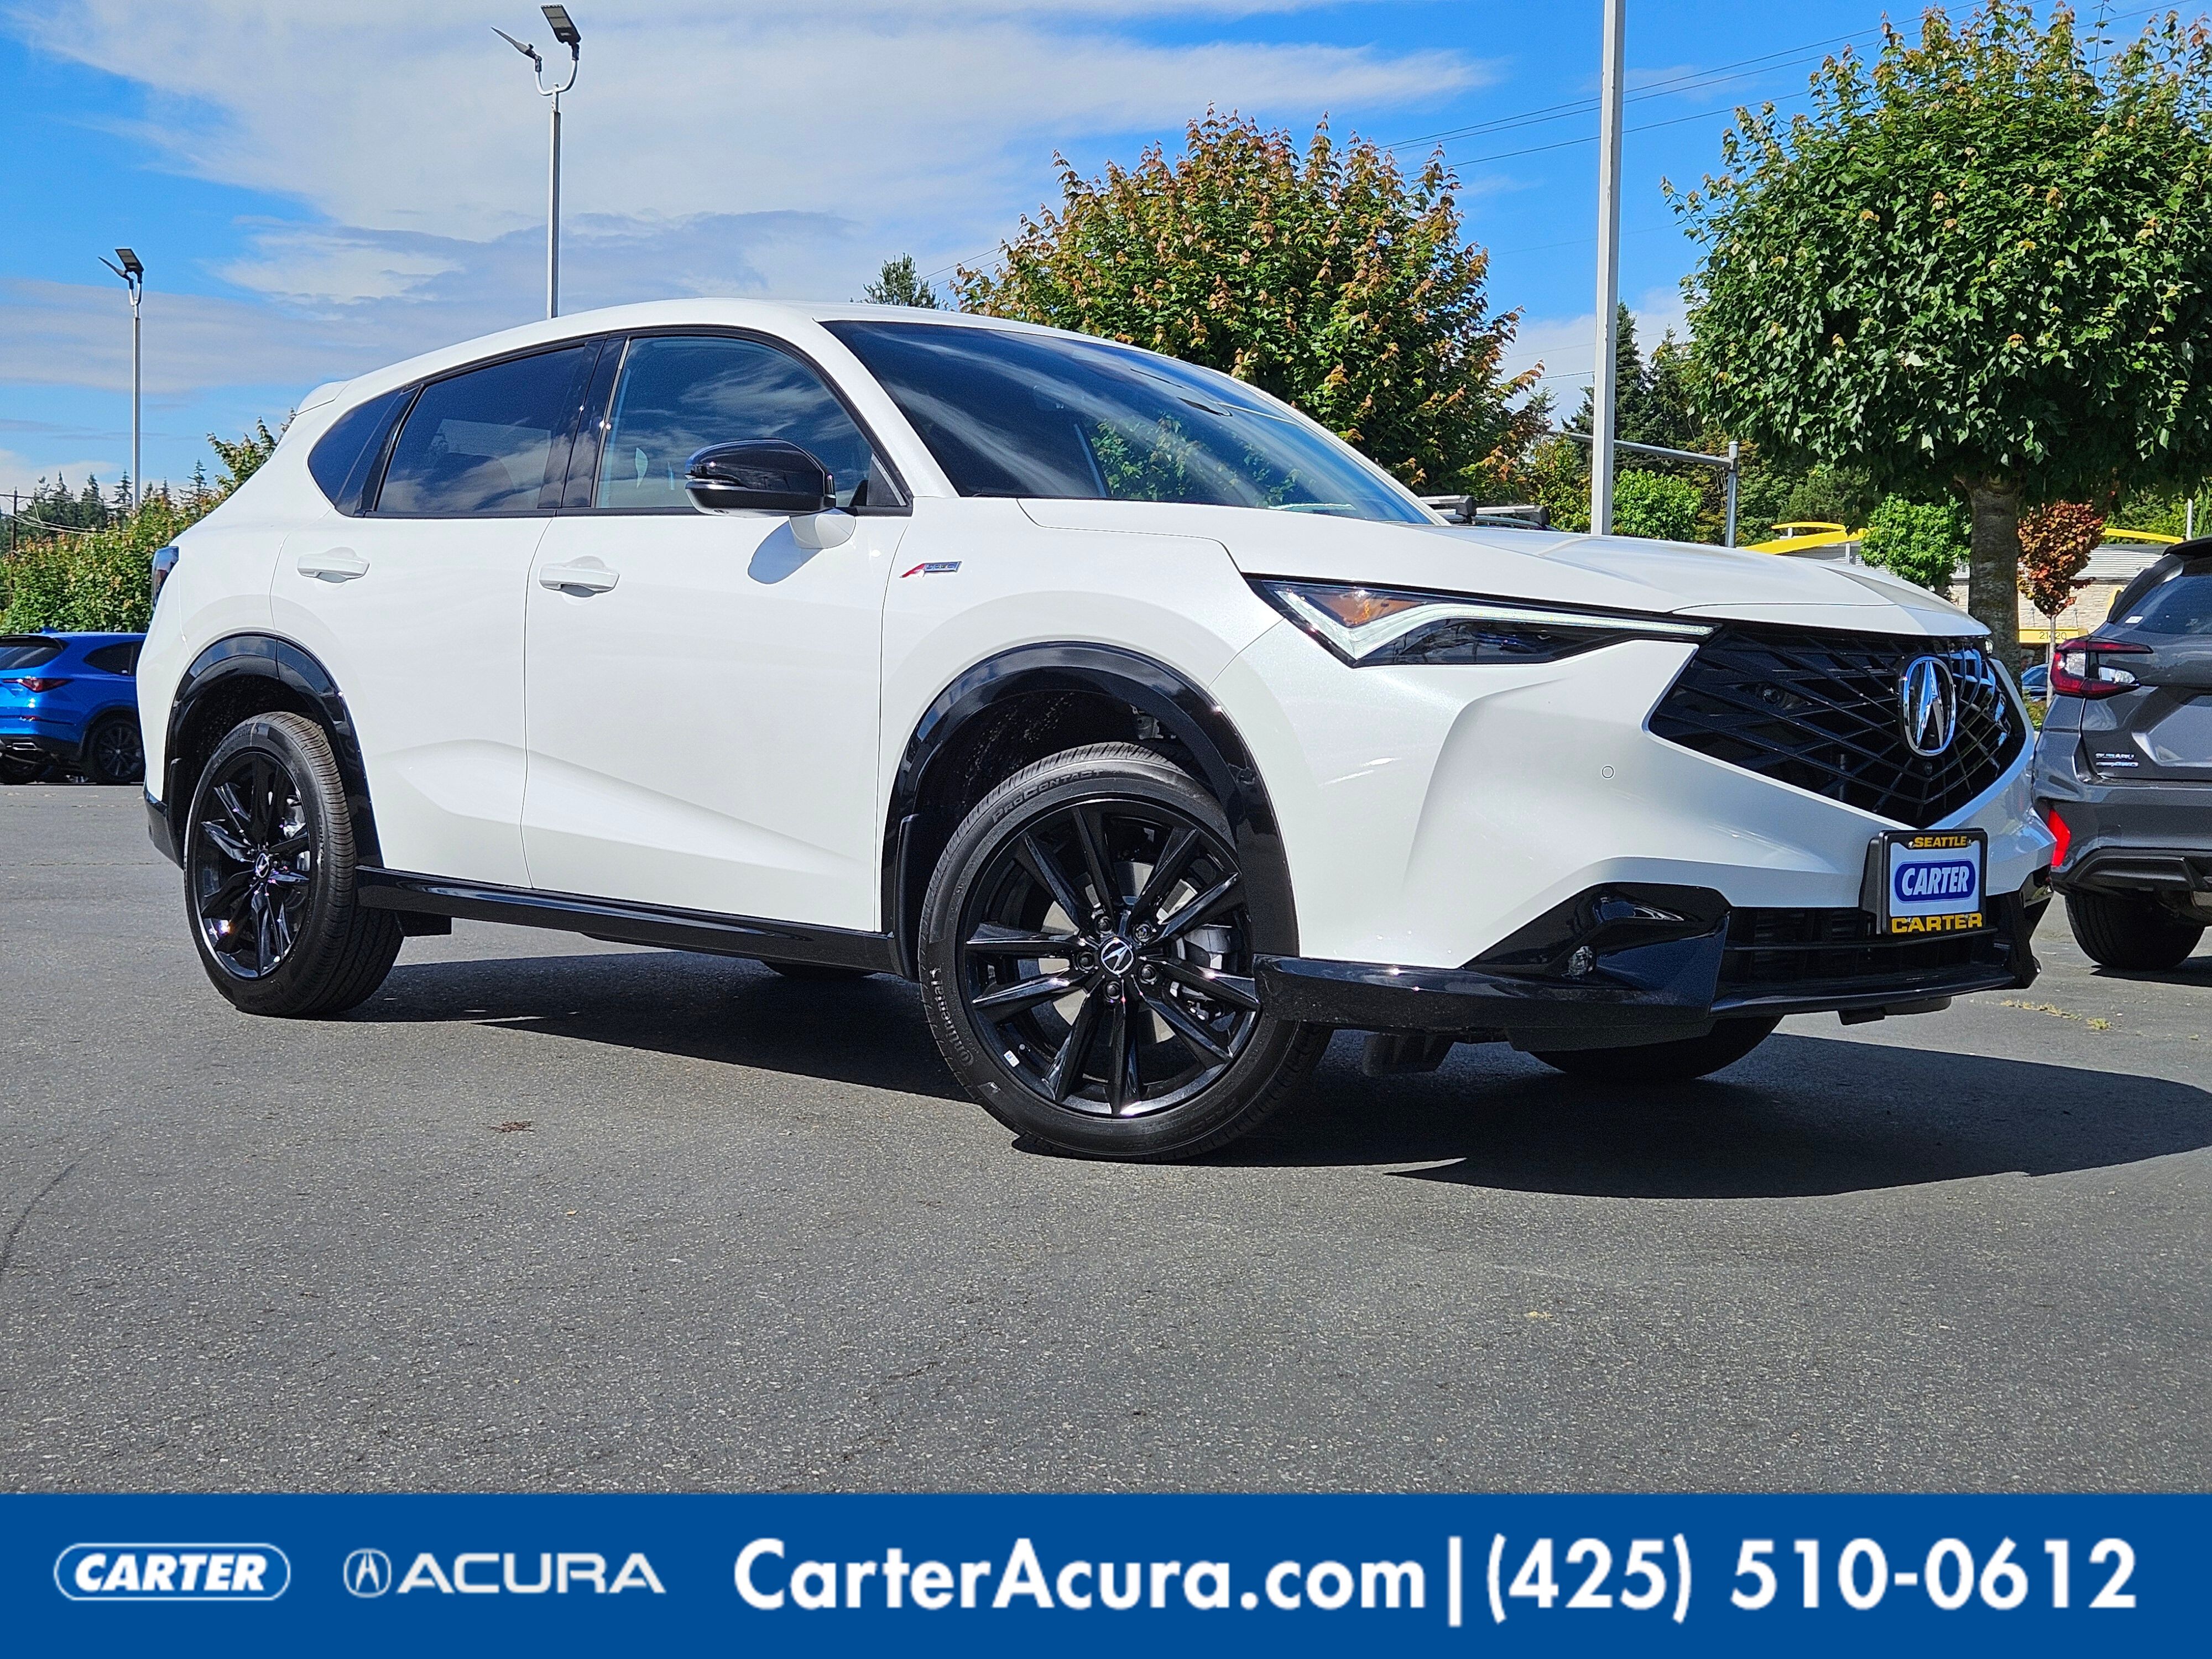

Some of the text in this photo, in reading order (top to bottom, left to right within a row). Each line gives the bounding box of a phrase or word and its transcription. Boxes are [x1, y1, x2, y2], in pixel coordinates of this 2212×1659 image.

[2039, 631, 2067, 640] 2120
[1914, 836, 1967, 847] SEATTLE
[1901, 865, 1970, 896] CARTER
[1891, 912, 1983, 933] CARTER
